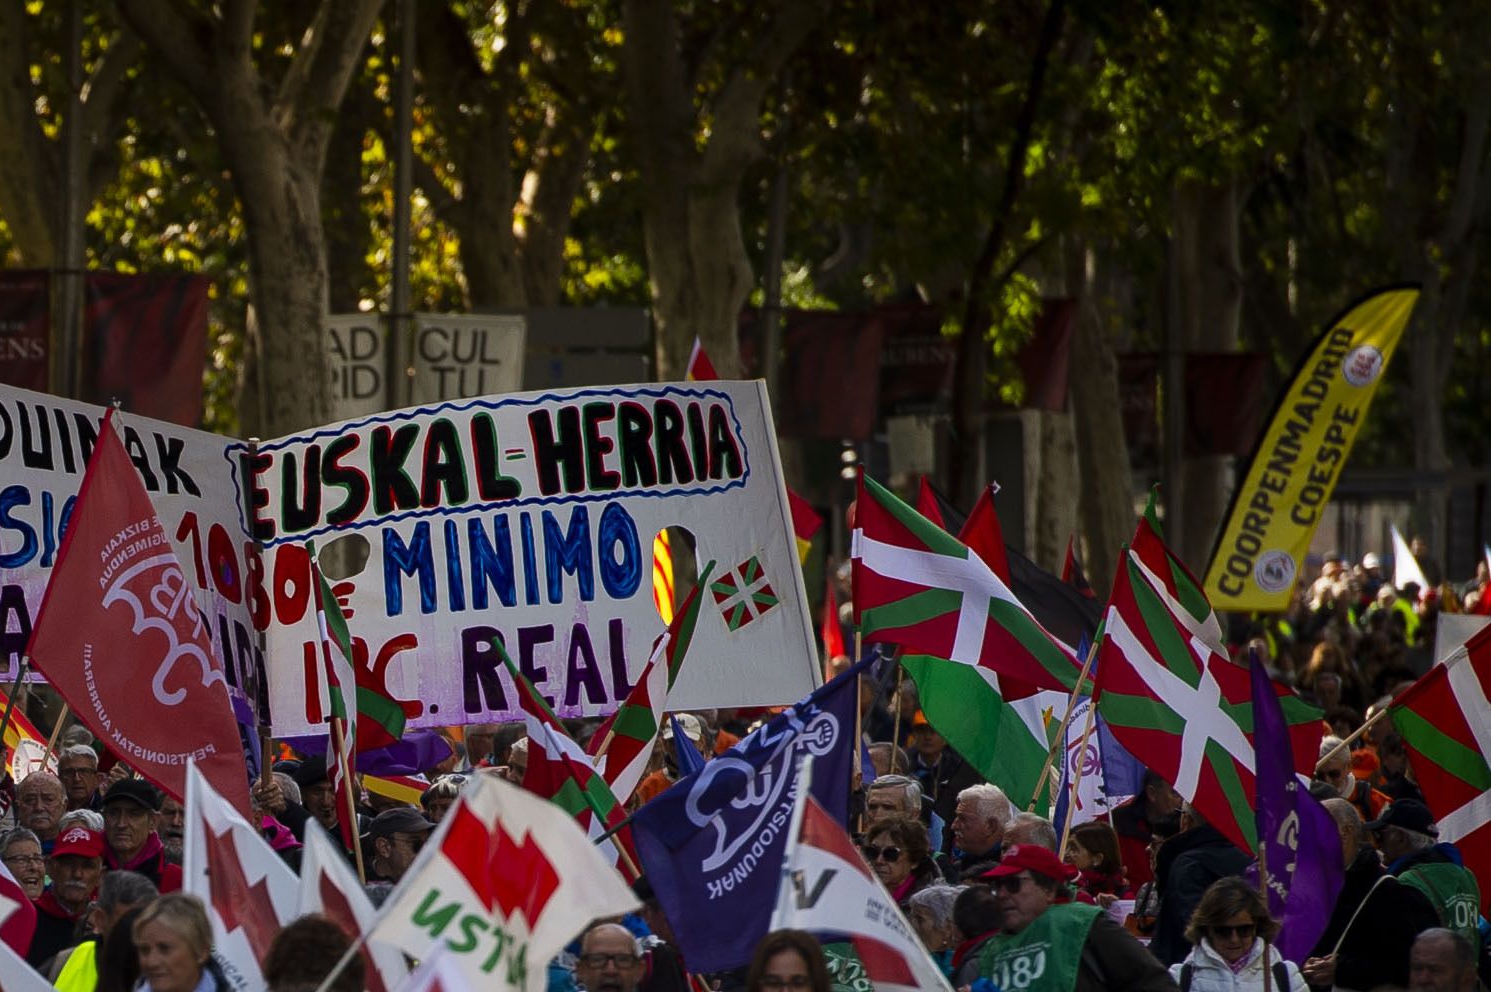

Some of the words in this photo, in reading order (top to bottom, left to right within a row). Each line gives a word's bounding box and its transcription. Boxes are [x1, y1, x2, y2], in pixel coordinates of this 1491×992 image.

[418, 327, 500, 364] CUL
[244, 400, 745, 542] EUSKAL-HERRIA
[1218, 327, 1355, 598] COORPENMADRID
[1290, 402, 1359, 528] COESPE
[381, 501, 644, 617] MINIMO
[460, 618, 638, 715] REAL
